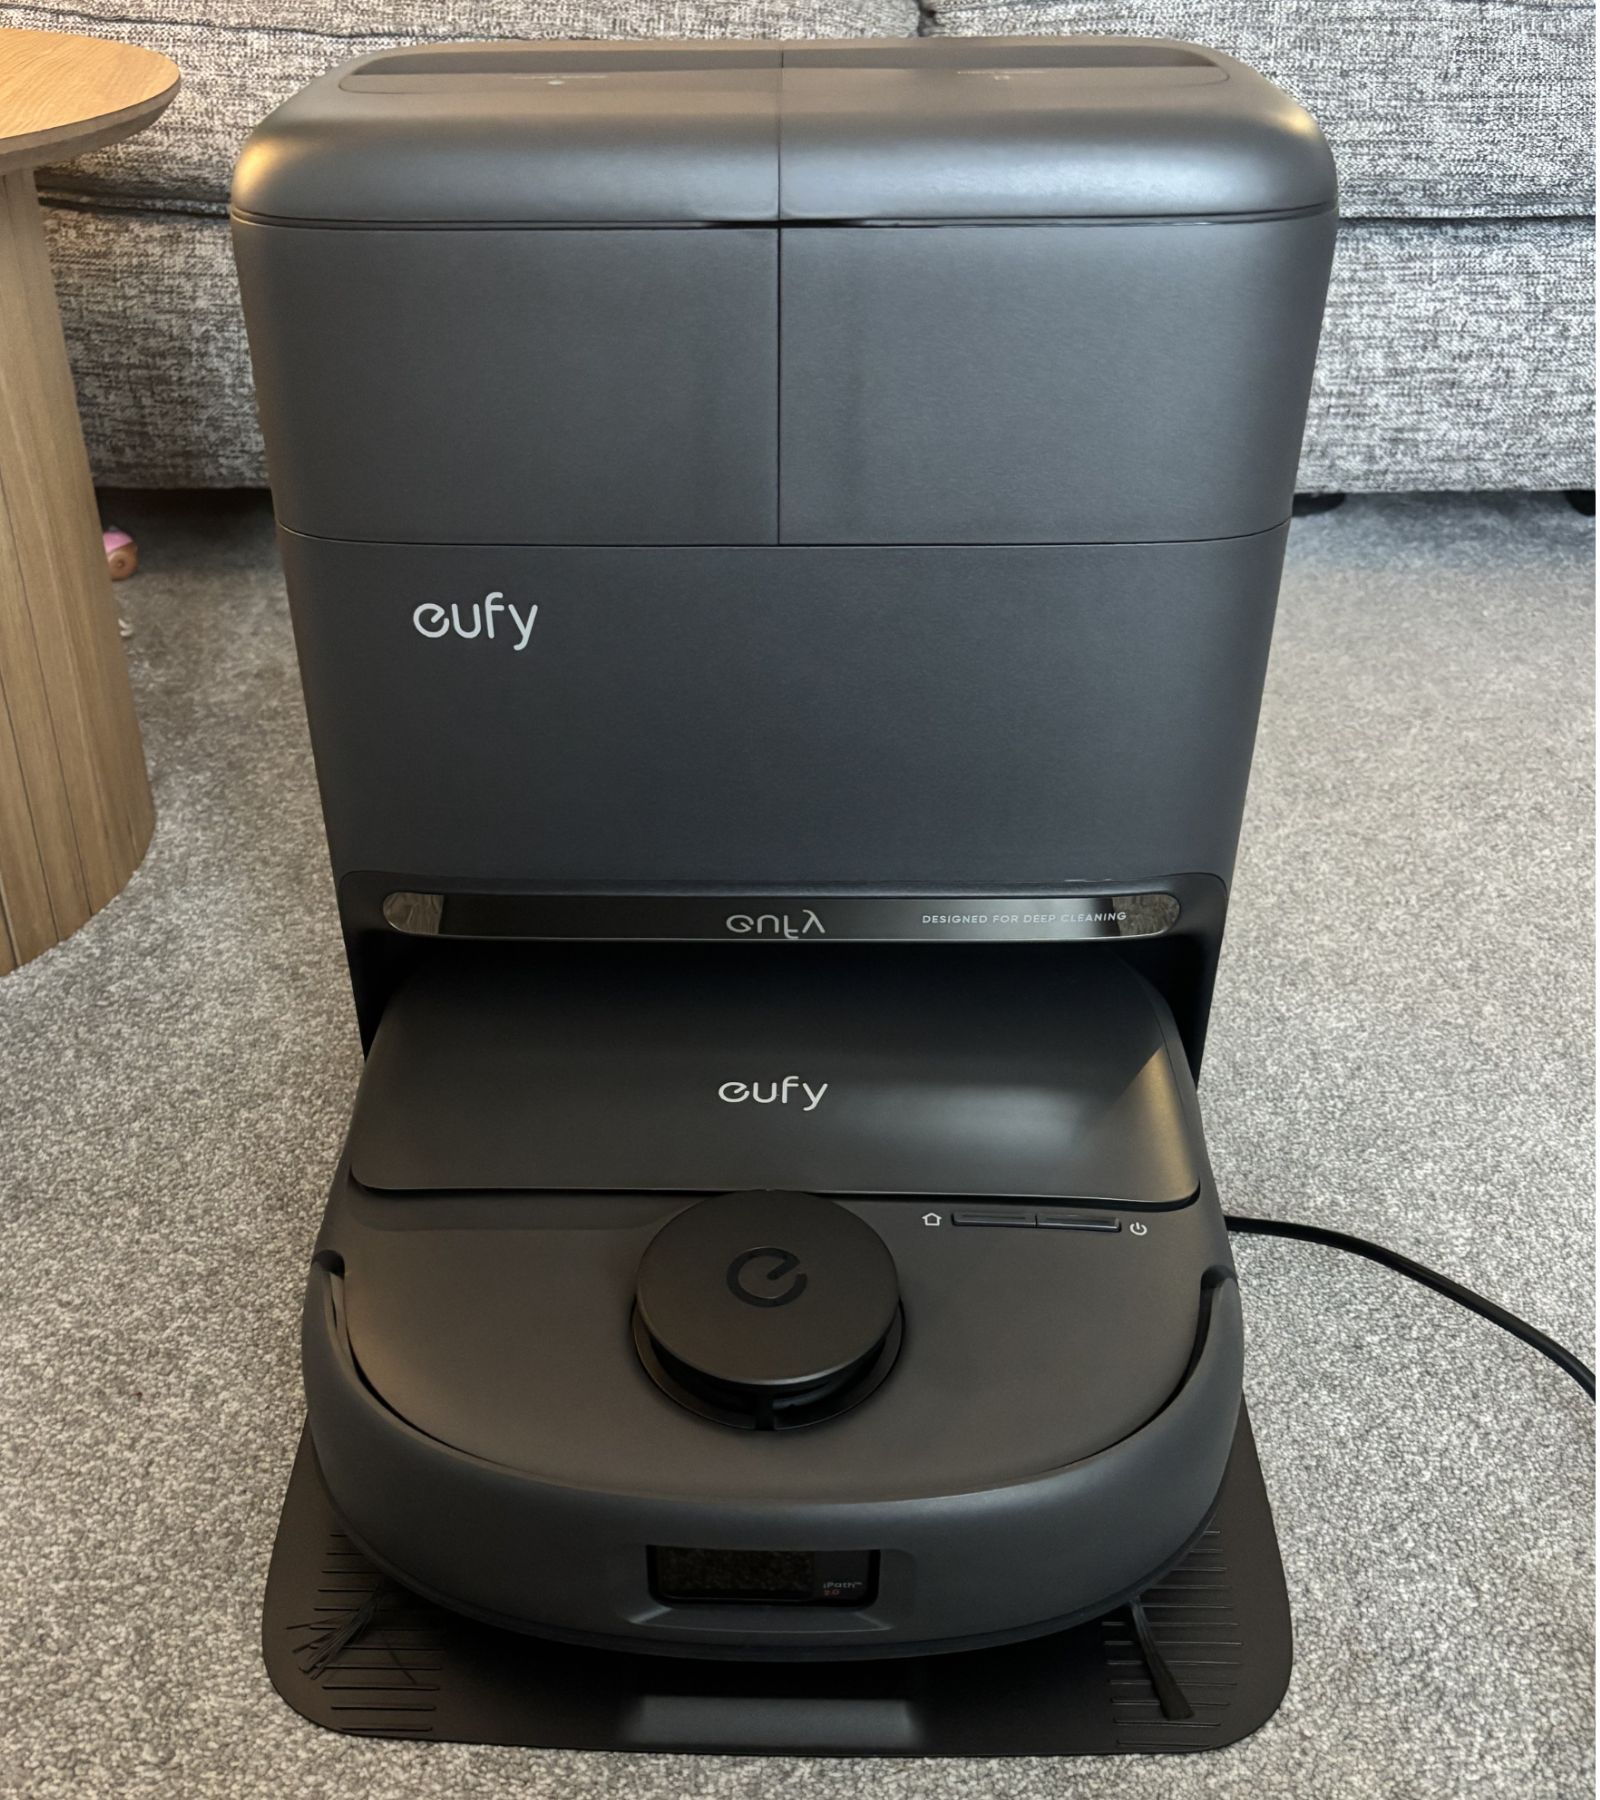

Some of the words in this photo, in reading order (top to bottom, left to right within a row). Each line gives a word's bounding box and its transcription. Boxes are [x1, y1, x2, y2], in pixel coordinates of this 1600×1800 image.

[412, 591, 539, 651] eufy
[922, 914, 988, 924] DESIGNED
[992, 914, 1019, 924] FOR
[1023, 914, 1055, 923] DEEP
[1060, 911, 1127, 922] CLEANING
[718, 1075, 829, 1112] eufy
